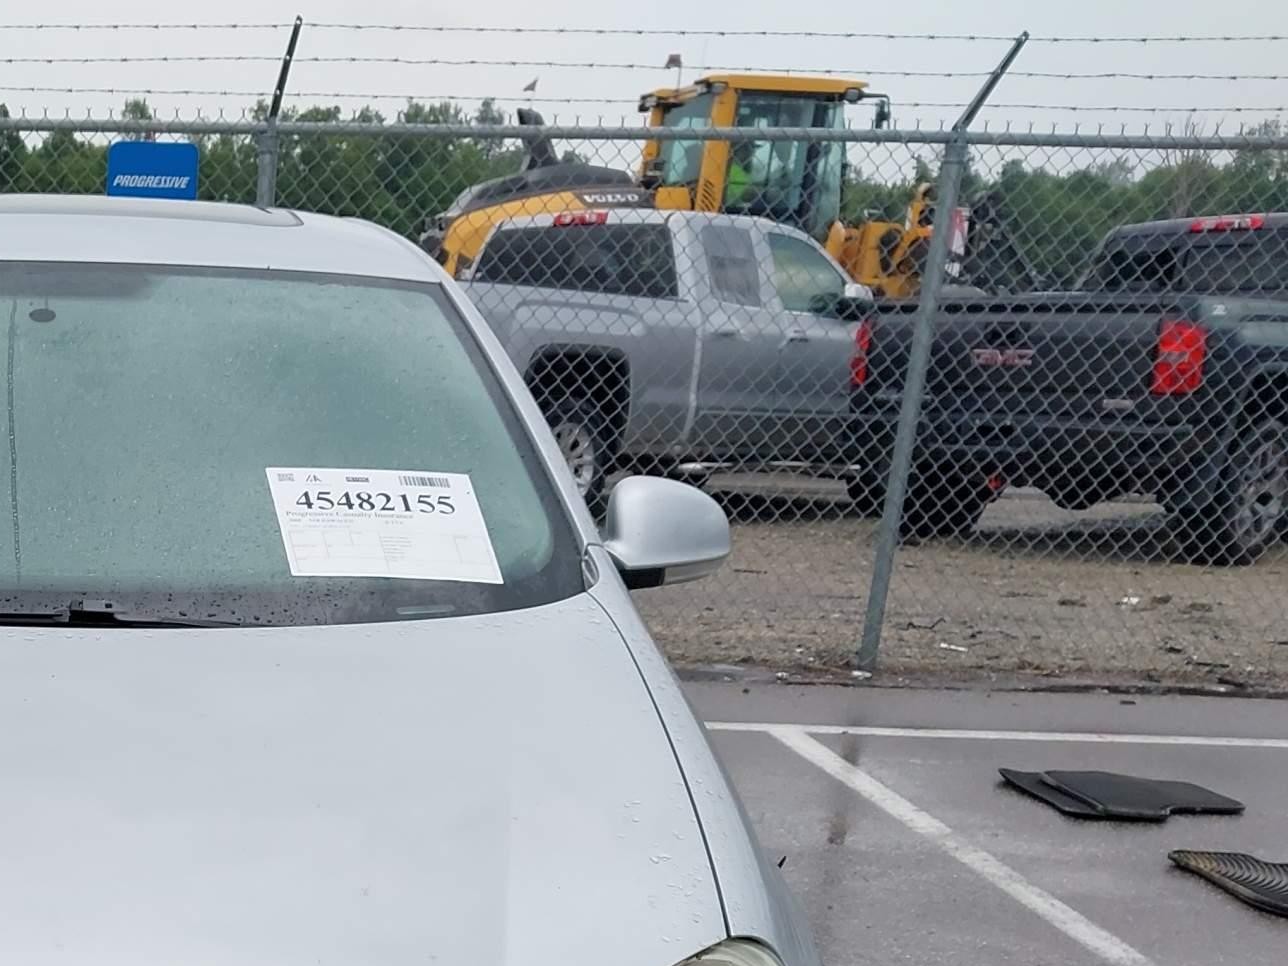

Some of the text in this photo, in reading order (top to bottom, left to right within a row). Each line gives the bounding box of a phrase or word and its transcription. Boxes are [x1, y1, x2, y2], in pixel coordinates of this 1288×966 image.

[113, 174, 191, 189] PROGRESSIVE
[584, 193, 640, 203] VOLVO
[296, 490, 455, 514] 45482155
